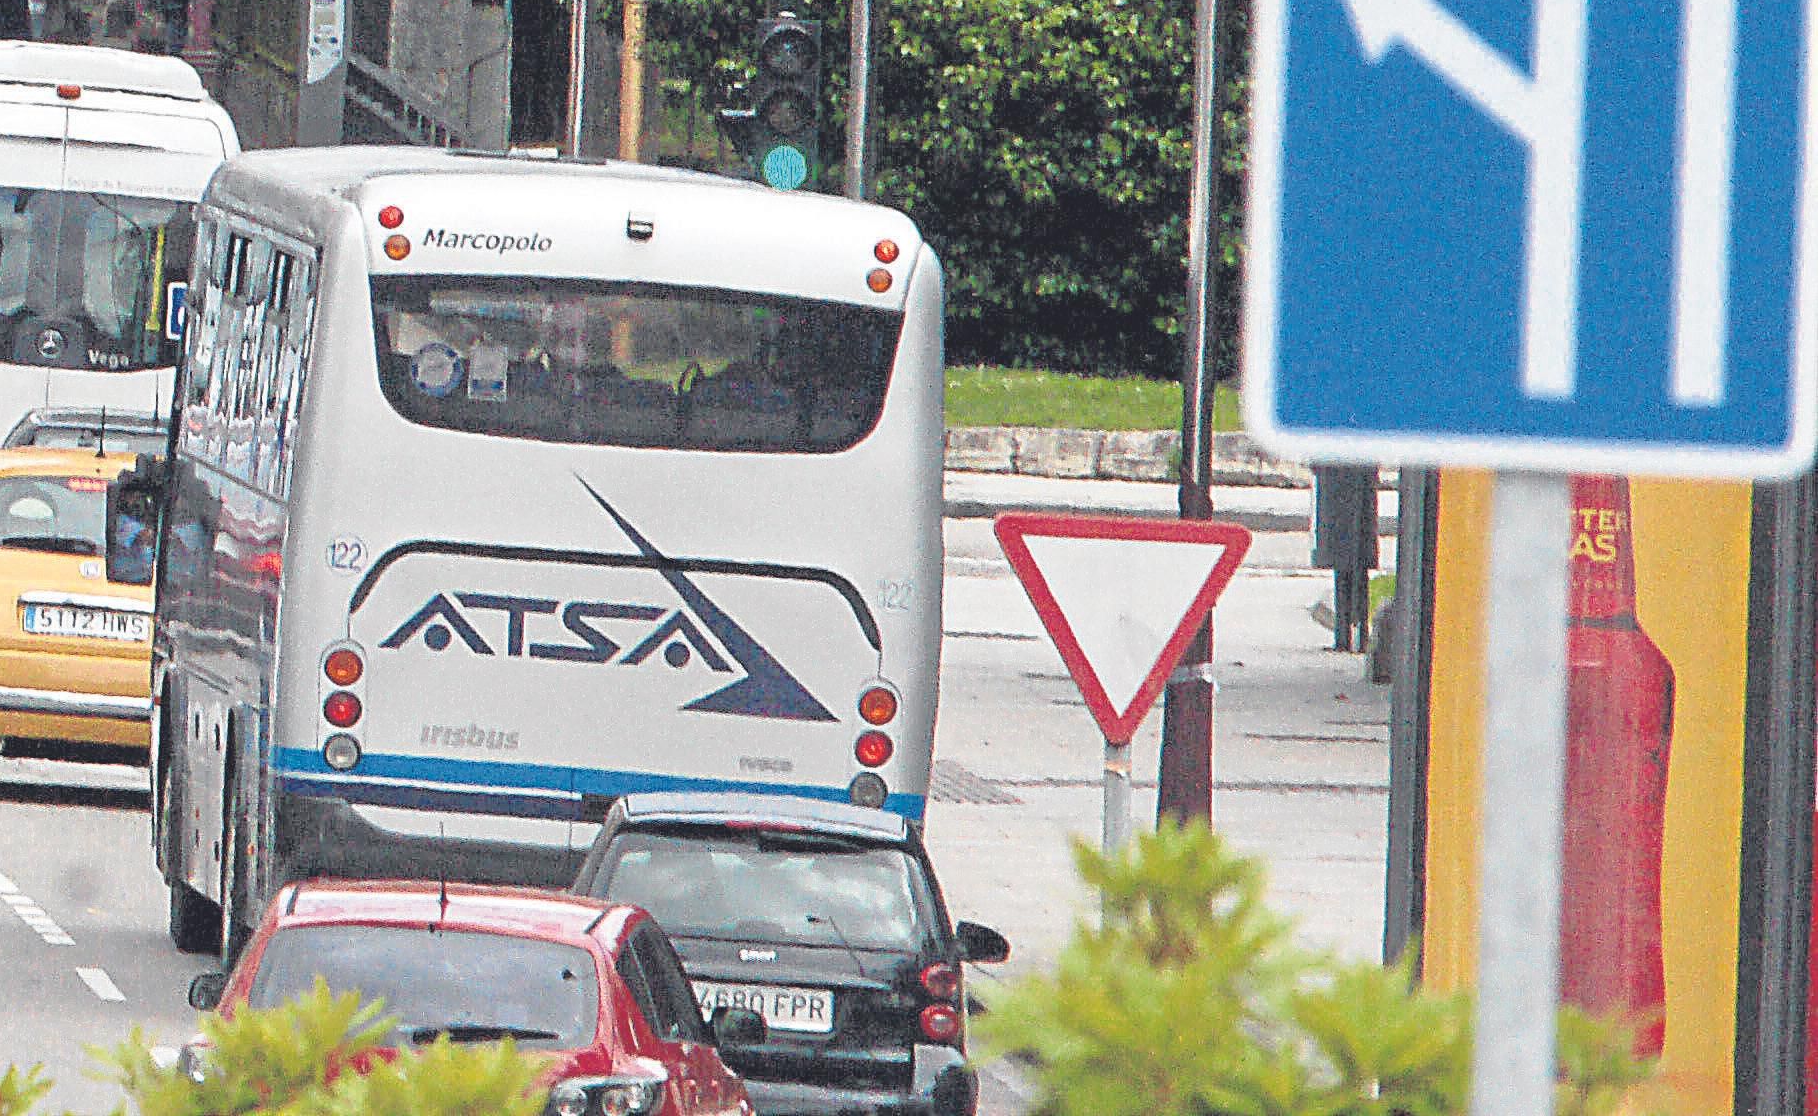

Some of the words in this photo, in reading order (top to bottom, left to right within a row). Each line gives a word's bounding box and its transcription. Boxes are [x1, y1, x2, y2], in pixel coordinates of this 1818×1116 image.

[422, 227, 553, 255] Marcopolo
[330, 542, 364, 571] 122
[40, 608, 94, 629] 5112
[102, 612, 145, 635] HWS
[378, 591, 735, 675] ATSA
[774, 994, 825, 1020] FPR
